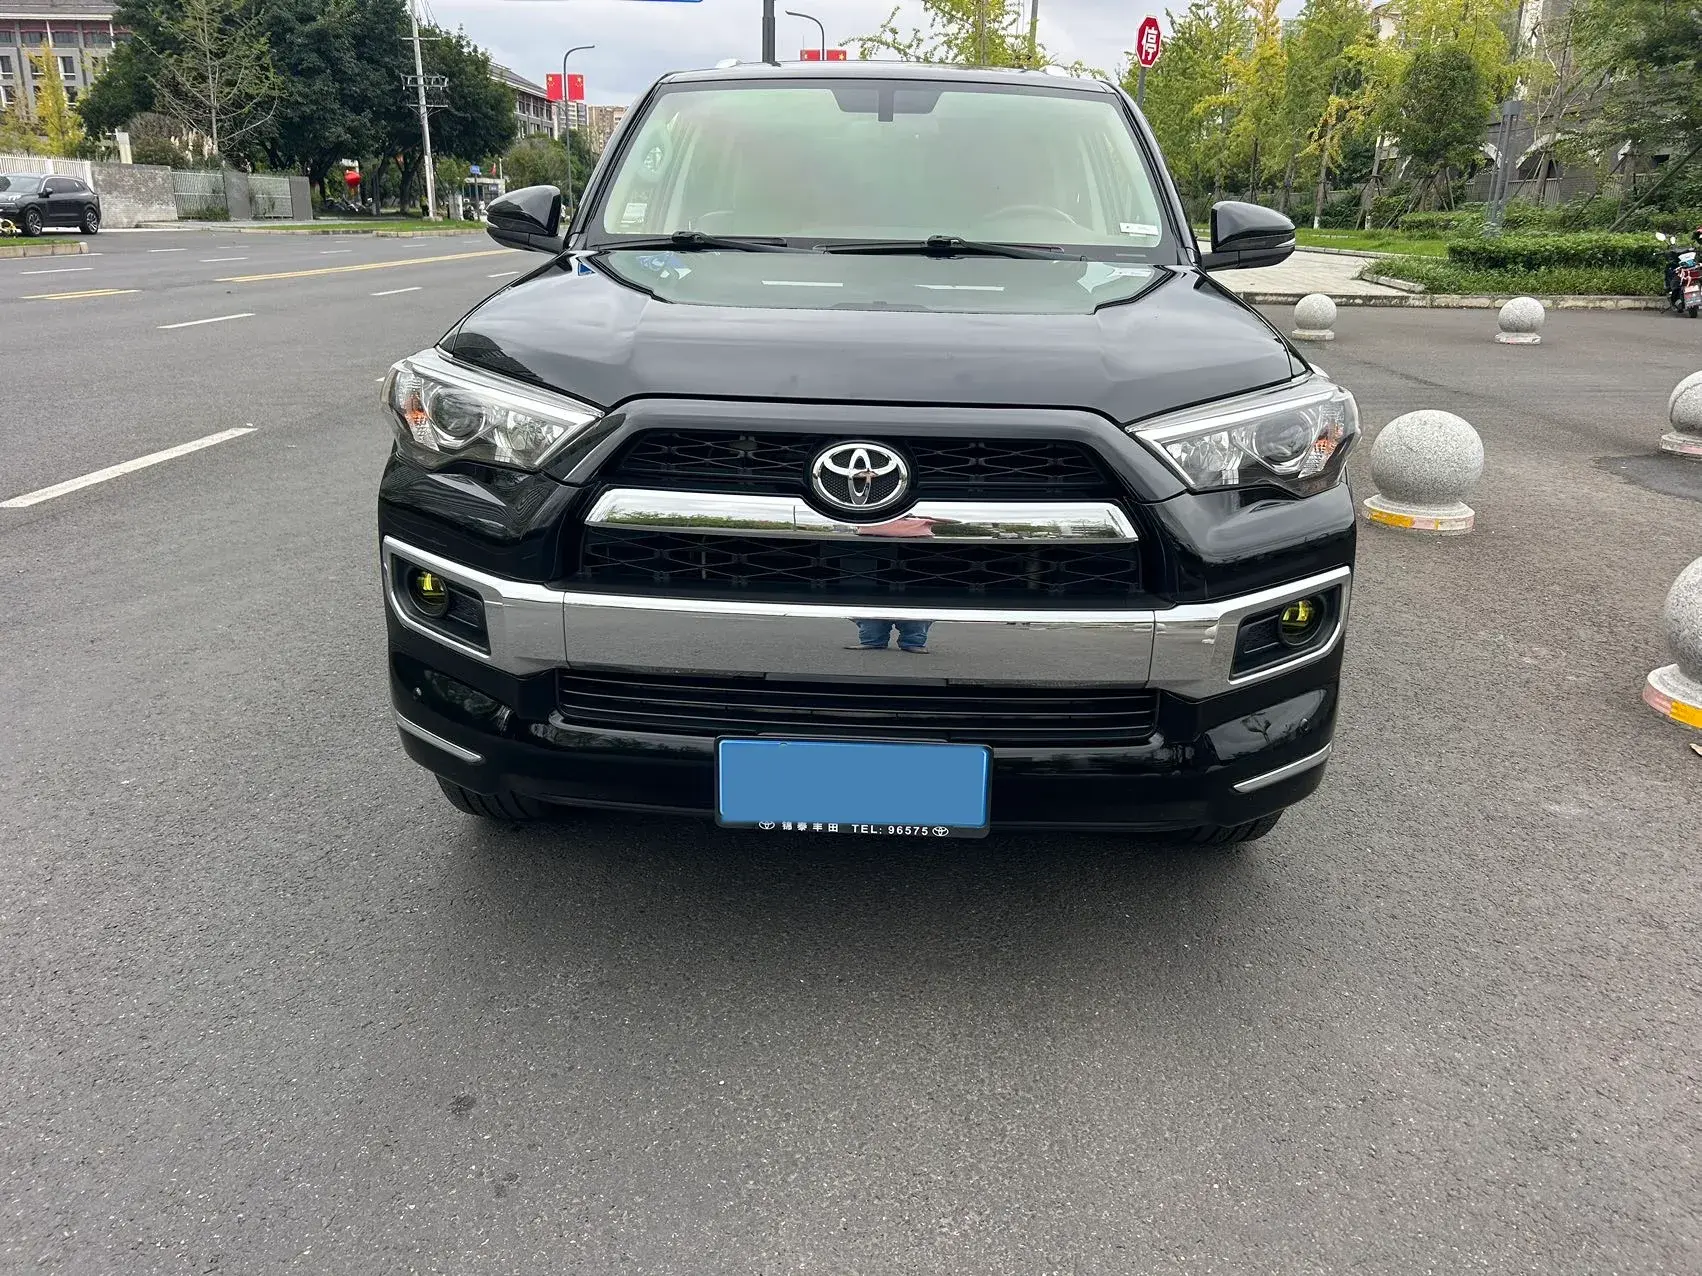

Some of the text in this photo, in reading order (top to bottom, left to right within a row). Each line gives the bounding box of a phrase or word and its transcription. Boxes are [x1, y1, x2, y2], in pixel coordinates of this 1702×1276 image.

[1141, 26, 1158, 60] 停
[851, 824, 882, 835] TEL:
[887, 825, 929, 836] 96575
